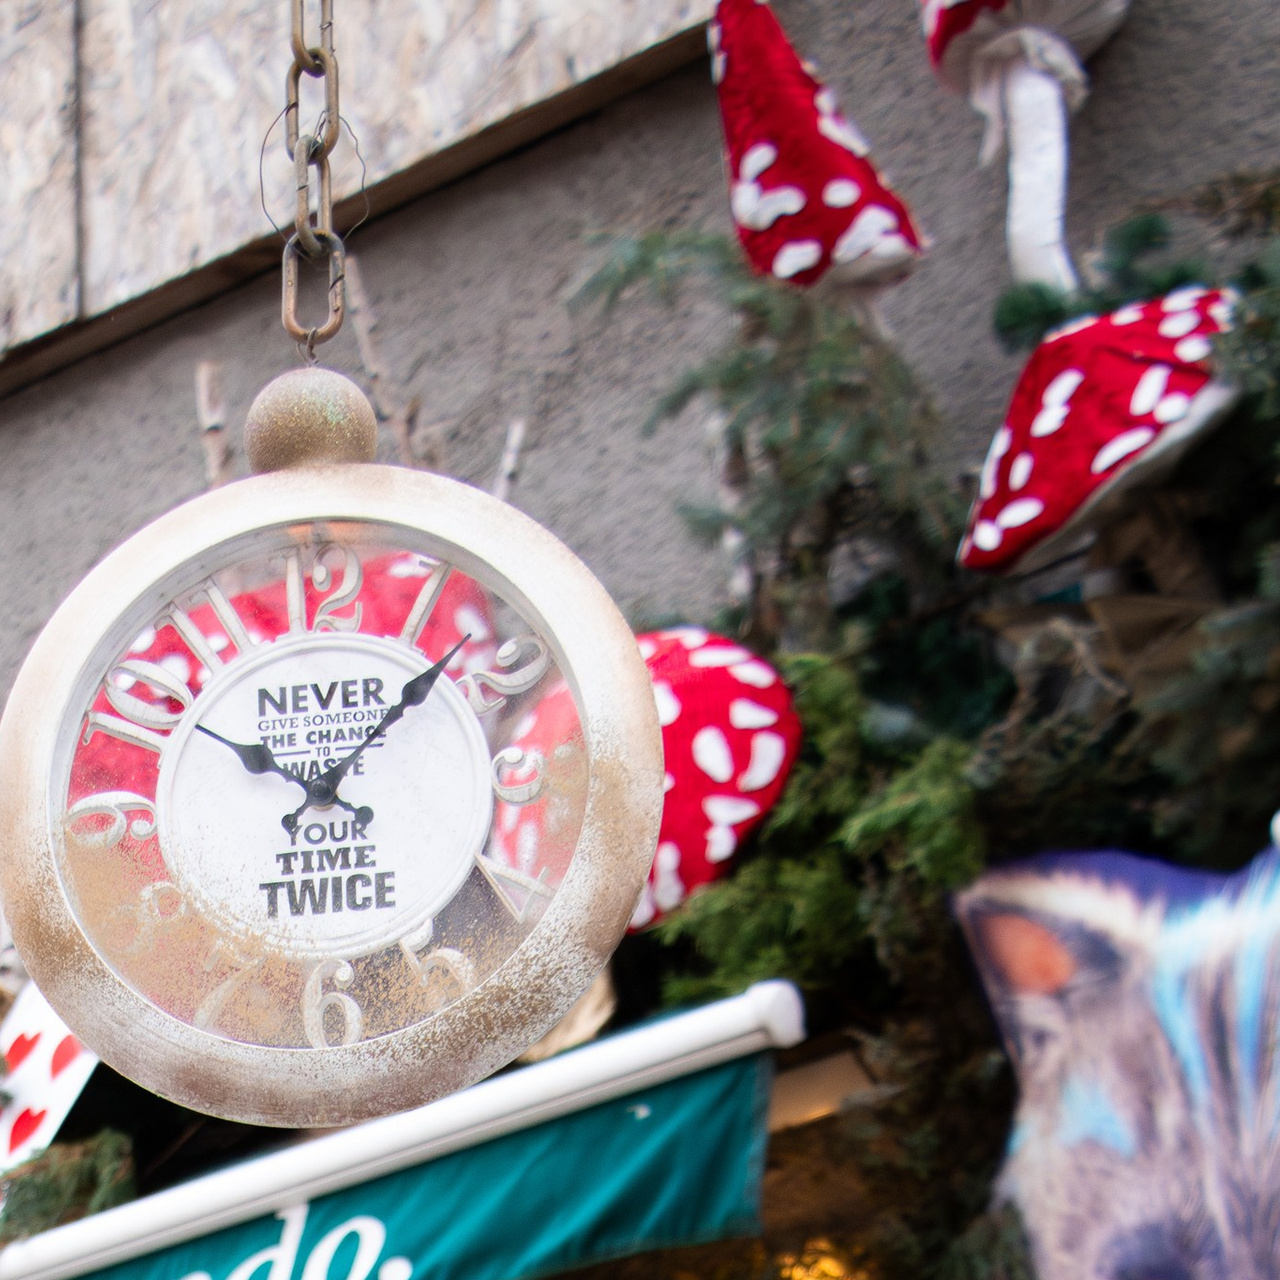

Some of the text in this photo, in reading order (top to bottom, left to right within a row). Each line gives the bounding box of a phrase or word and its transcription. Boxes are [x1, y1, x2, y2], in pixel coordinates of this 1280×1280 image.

[270, 544, 363, 636] 12
[401, 556, 452, 646] 1
[154, 573, 262, 687] 11
[257, 677, 387, 717] NEVER
[456, 638, 551, 716] 2
[82, 657, 194, 769] 10
[258, 717, 299, 732] GIVE
[260, 733, 297, 749] THE
[283, 755, 365, 783] WASE
[315, 746, 331, 757] TO
[491, 743, 585, 804] 3
[64, 790, 158, 847] 9
[289, 820, 368, 846] YOUR
[276, 845, 376, 875] TIME
[475, 852, 557, 922] 4
[259, 871, 396, 919] TWICE
[400, 918, 477, 1008] 5
[302, 957, 363, 1048] 6
